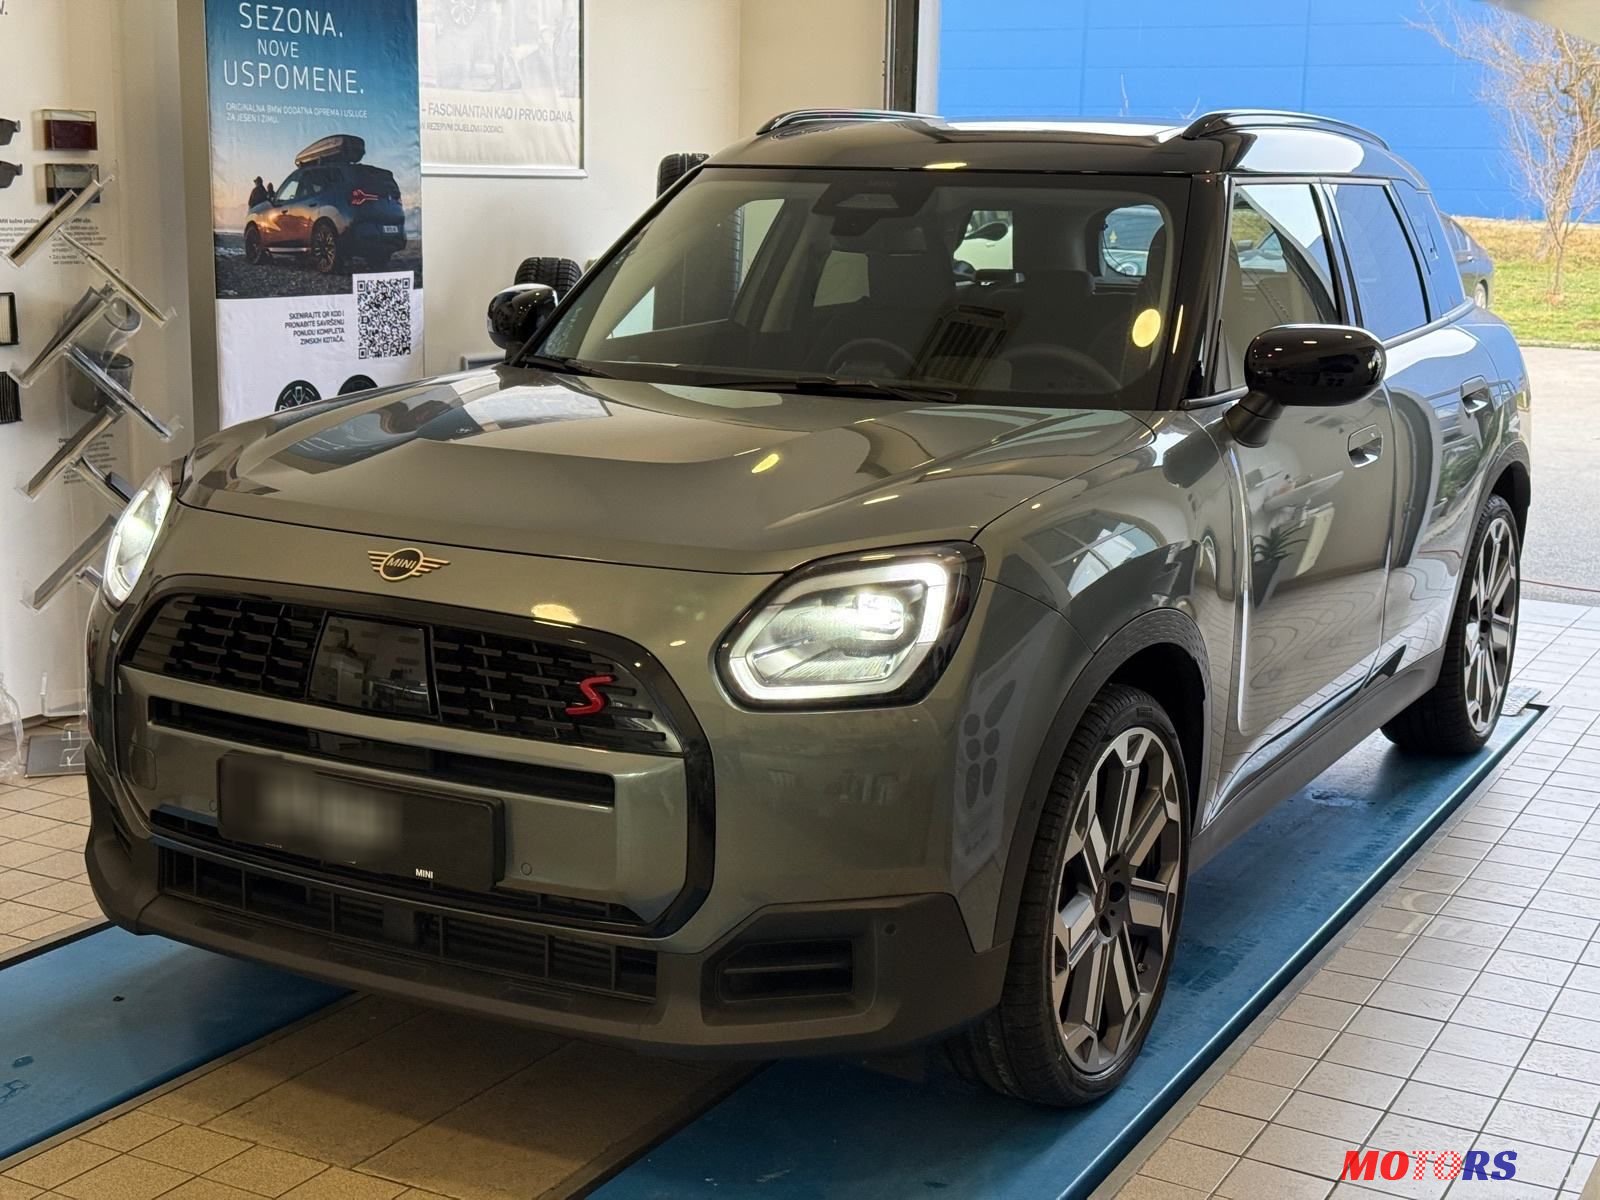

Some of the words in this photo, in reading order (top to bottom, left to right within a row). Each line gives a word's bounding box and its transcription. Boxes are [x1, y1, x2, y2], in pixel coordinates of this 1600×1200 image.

[239, 2, 344, 38] SEZONA.
[257, 38, 300, 58] NOVE
[223, 60, 365, 95] USPOMENE.
[225, 102, 266, 113] ORIGINALNA
[428, 102, 493, 119] FASCINANTAN
[494, 106, 513, 120] KAO
[519, 107, 549, 122] PRVOG
[550, 110, 575, 123] DANA.
[386, 557, 417, 570] MINI
[564, 675, 613, 715] S
[415, 868, 434, 879] MINI
